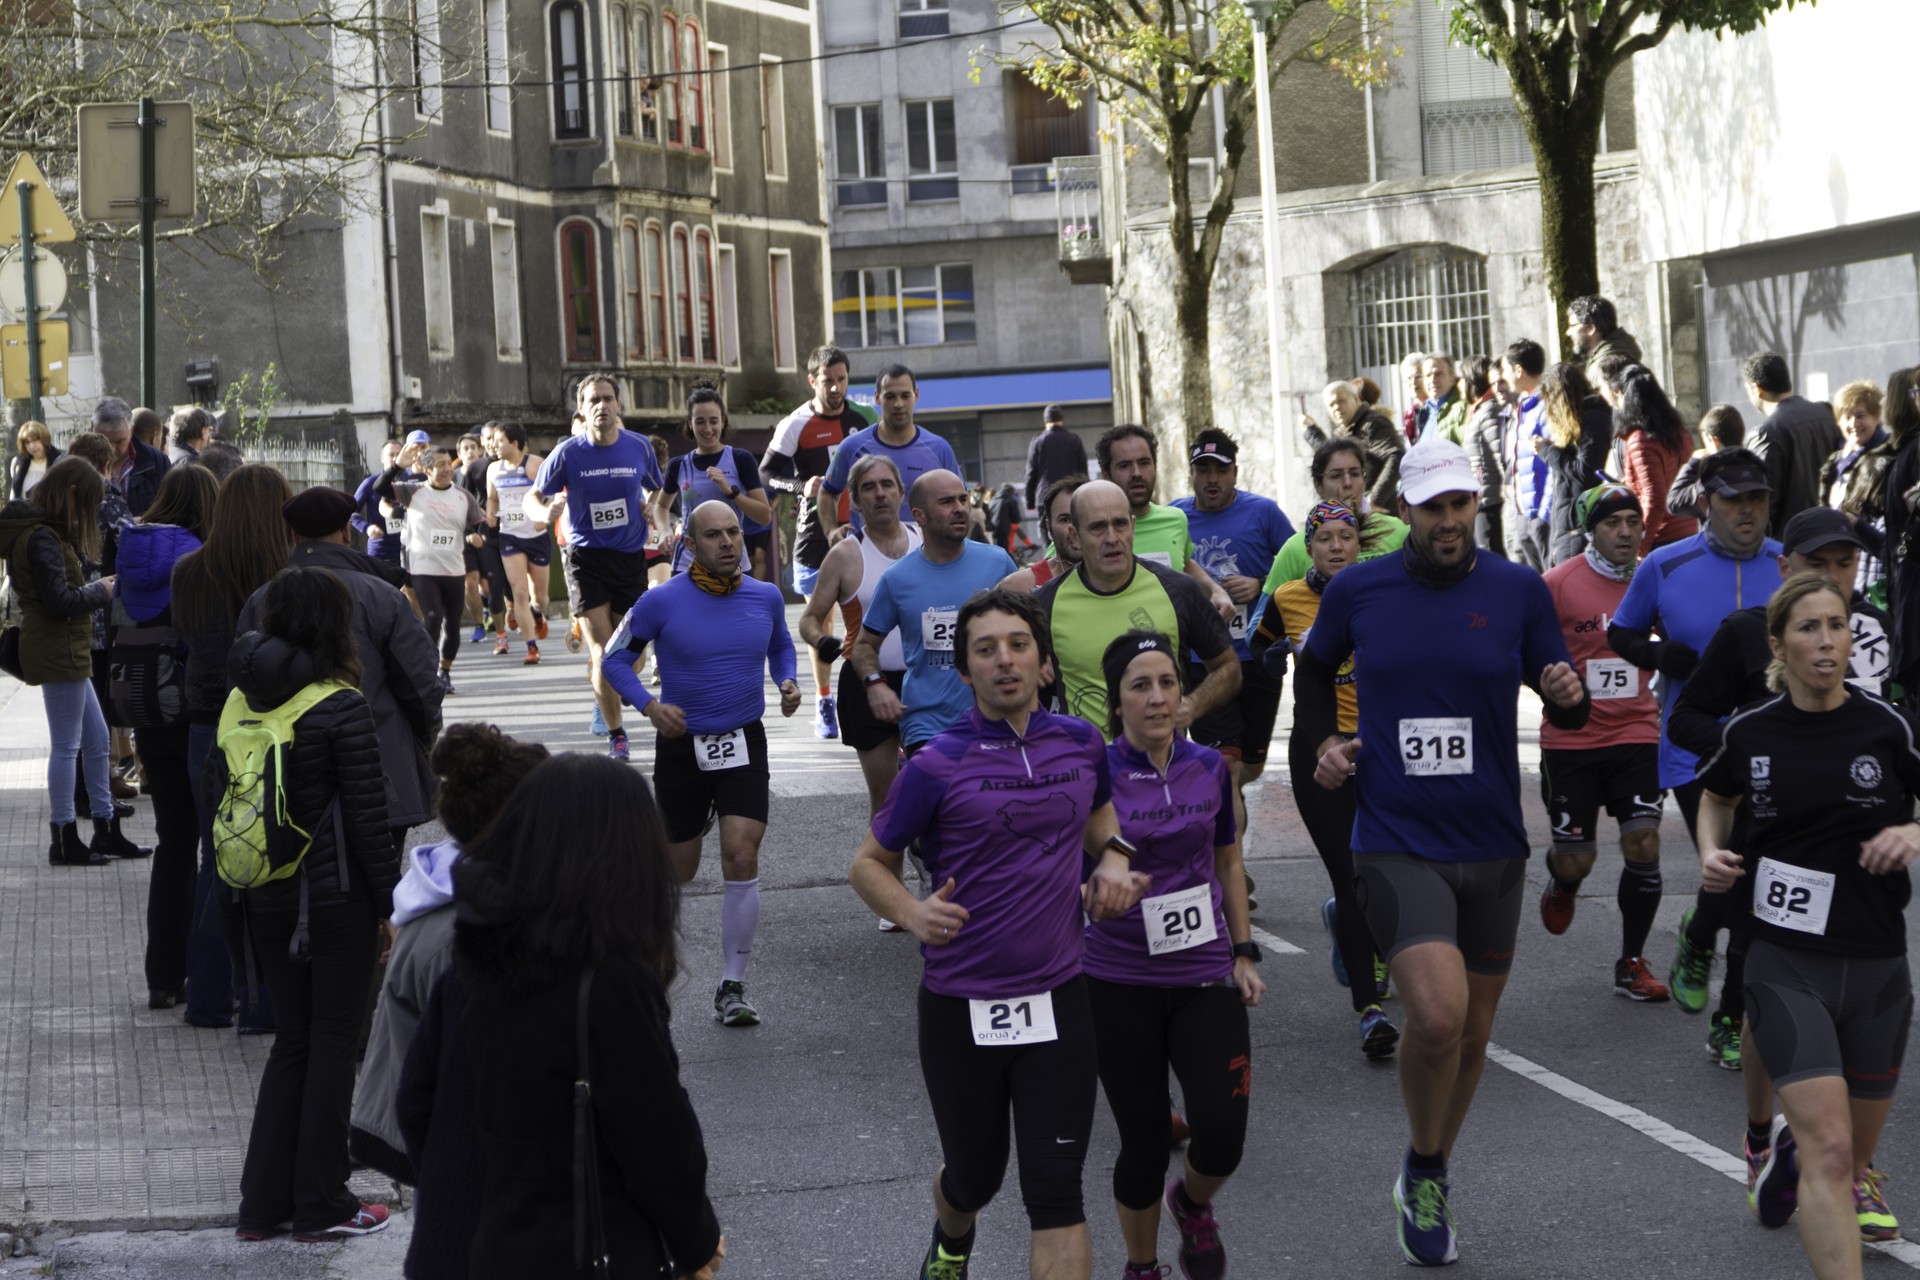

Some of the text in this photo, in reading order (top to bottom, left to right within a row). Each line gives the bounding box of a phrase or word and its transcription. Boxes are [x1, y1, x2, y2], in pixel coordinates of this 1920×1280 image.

[584, 468, 609, 477] LAUDIO
[506, 513, 525, 522] 332
[594, 507, 625, 523] 263
[432, 535, 454, 546] 287
[1574, 613, 1600, 634] aek
[1599, 670, 1628, 689] 75
[706, 741, 735, 760] 22
[1405, 735, 1466, 761] 318
[1042, 767, 1081, 786] Trail
[1178, 799, 1212, 817] Trail
[1767, 880, 1812, 915] 82
[1163, 906, 1202, 936] 20
[989, 1001, 1033, 1030] 21
[978, 1030, 1009, 1040] orrua
